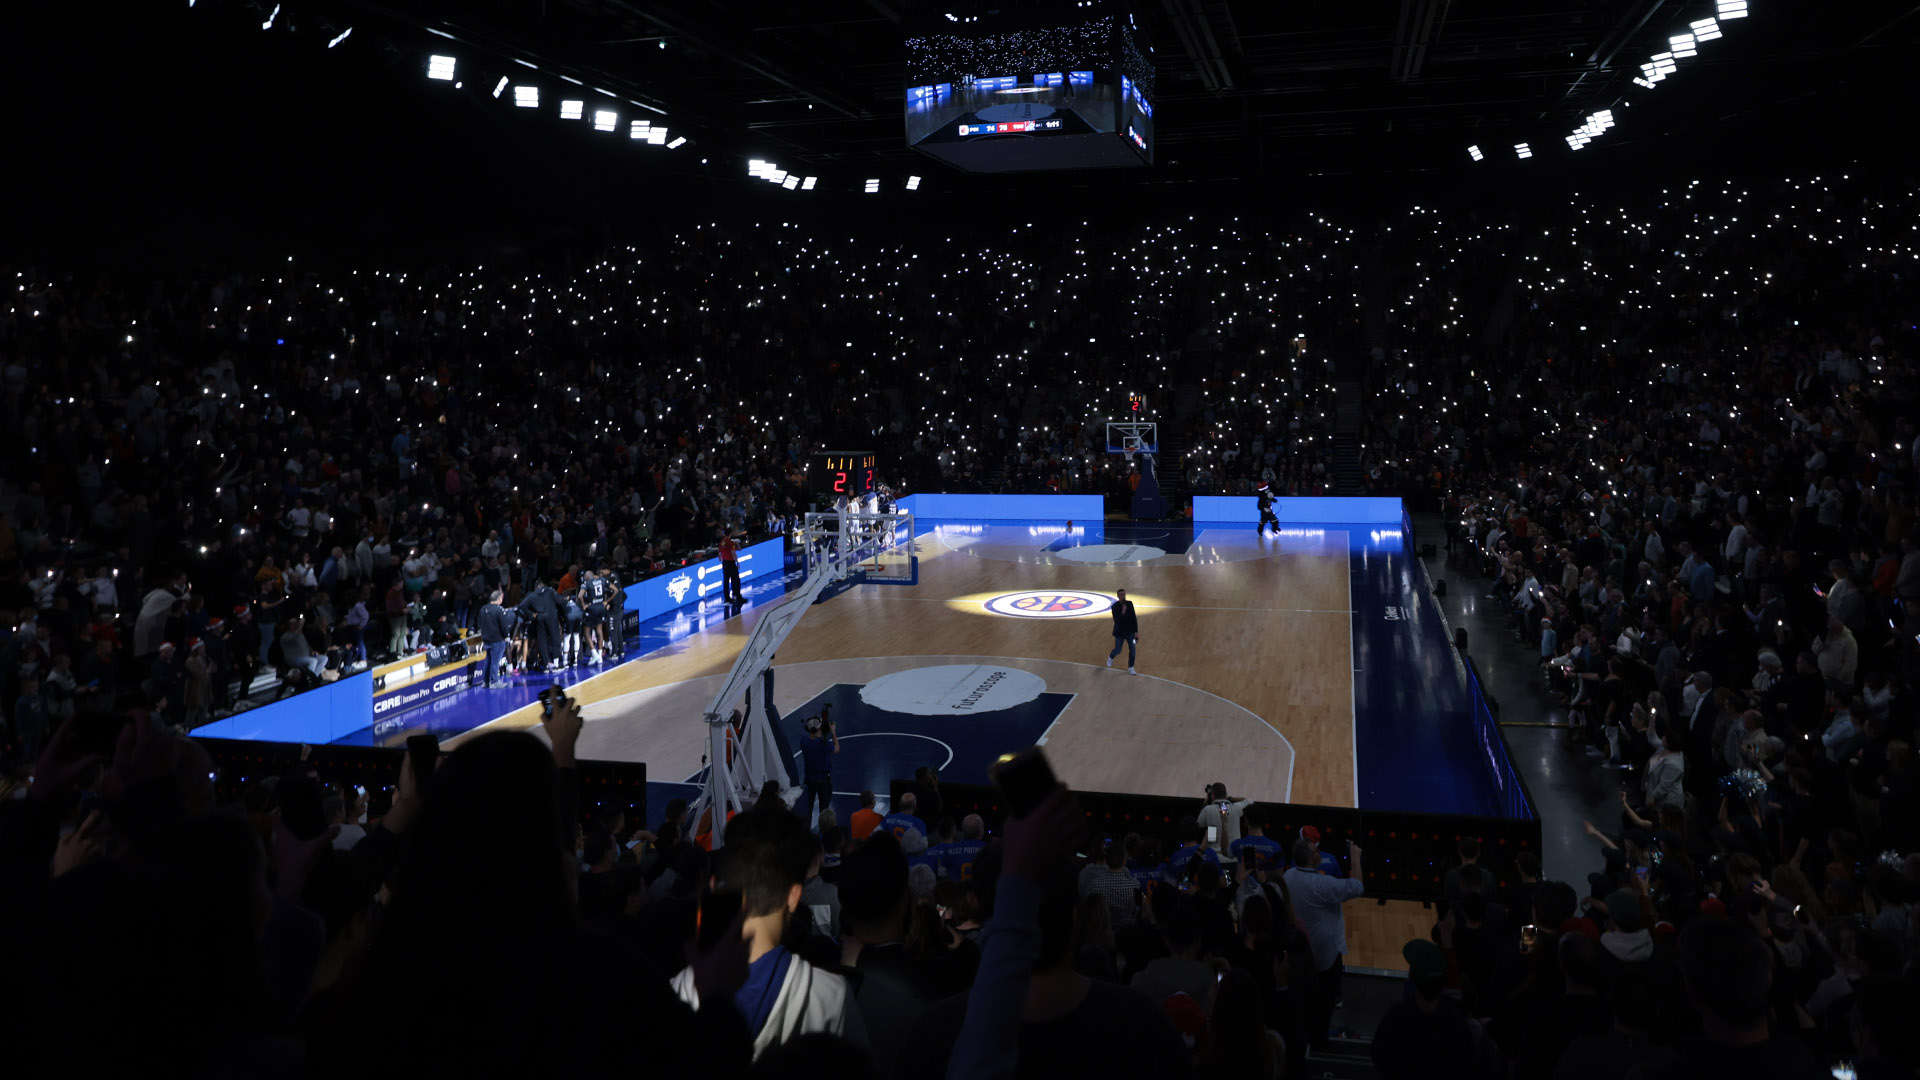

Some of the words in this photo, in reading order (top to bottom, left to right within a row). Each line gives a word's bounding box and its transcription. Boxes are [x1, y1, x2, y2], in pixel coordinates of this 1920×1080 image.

[834, 472, 847, 493] 2
[866, 470, 873, 490] 2
[433, 675, 458, 693] CBRE
[374, 695, 401, 714] CBRE
